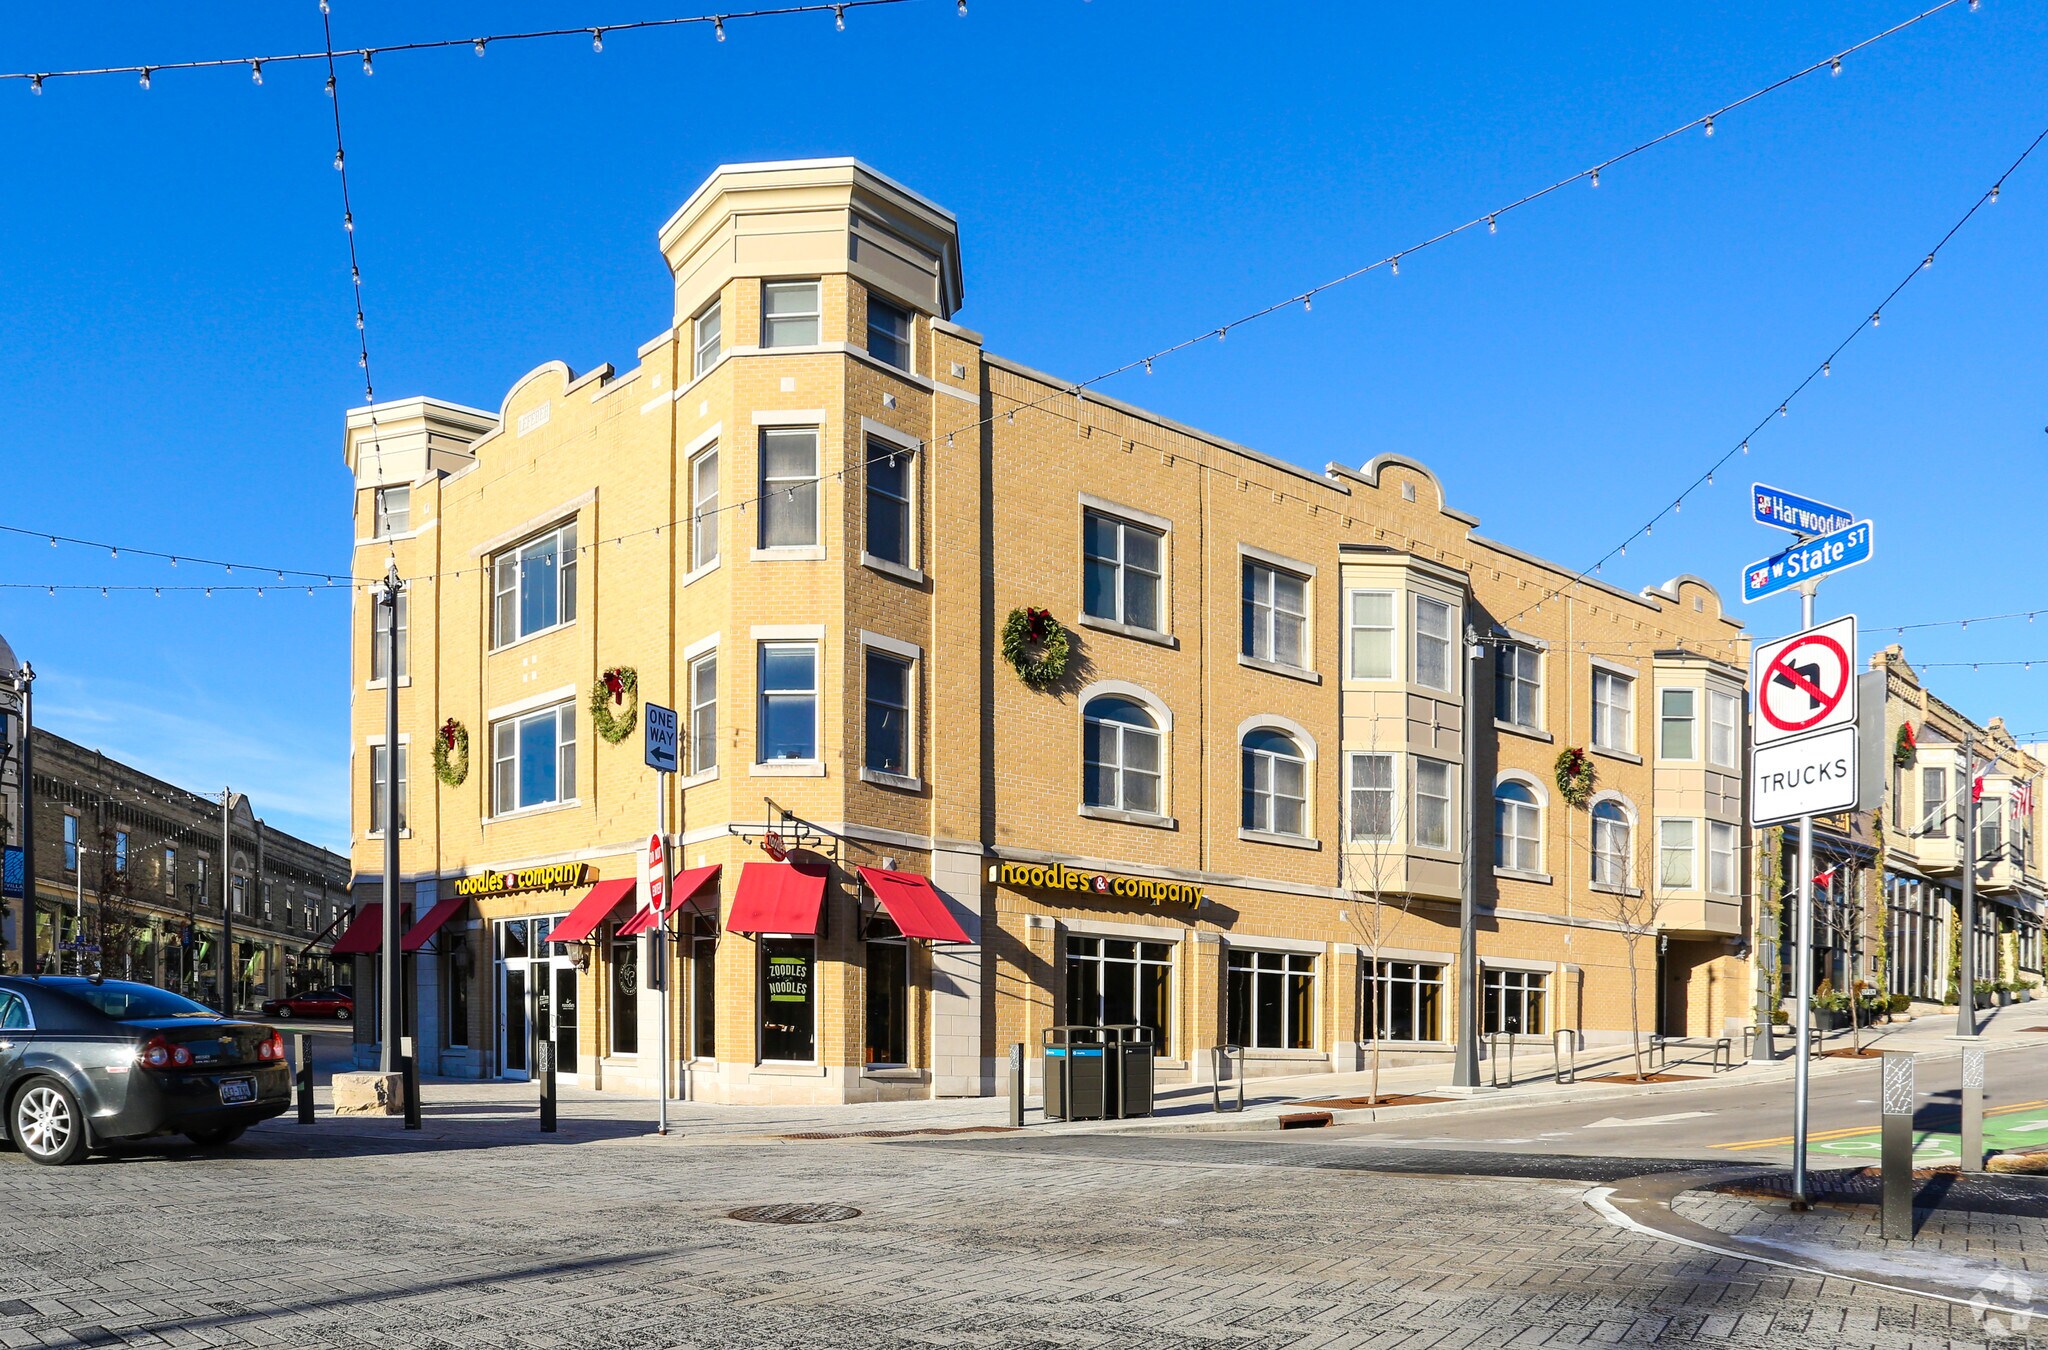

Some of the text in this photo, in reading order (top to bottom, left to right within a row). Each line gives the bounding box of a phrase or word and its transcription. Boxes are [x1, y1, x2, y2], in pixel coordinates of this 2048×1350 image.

[1773, 496, 1834, 534] Harwood
[1787, 541, 1844, 578] State
[1848, 527, 1866, 547] ST
[650, 709, 674, 729] ONE
[650, 727, 674, 746] WAY
[1760, 759, 1847, 793] TRUCKS
[455, 863, 582, 895] noodles & company
[1001, 862, 1204, 910] noodles & company
[769, 965, 807, 977] ZOODLES
[769, 982, 807, 994] NOODLES
